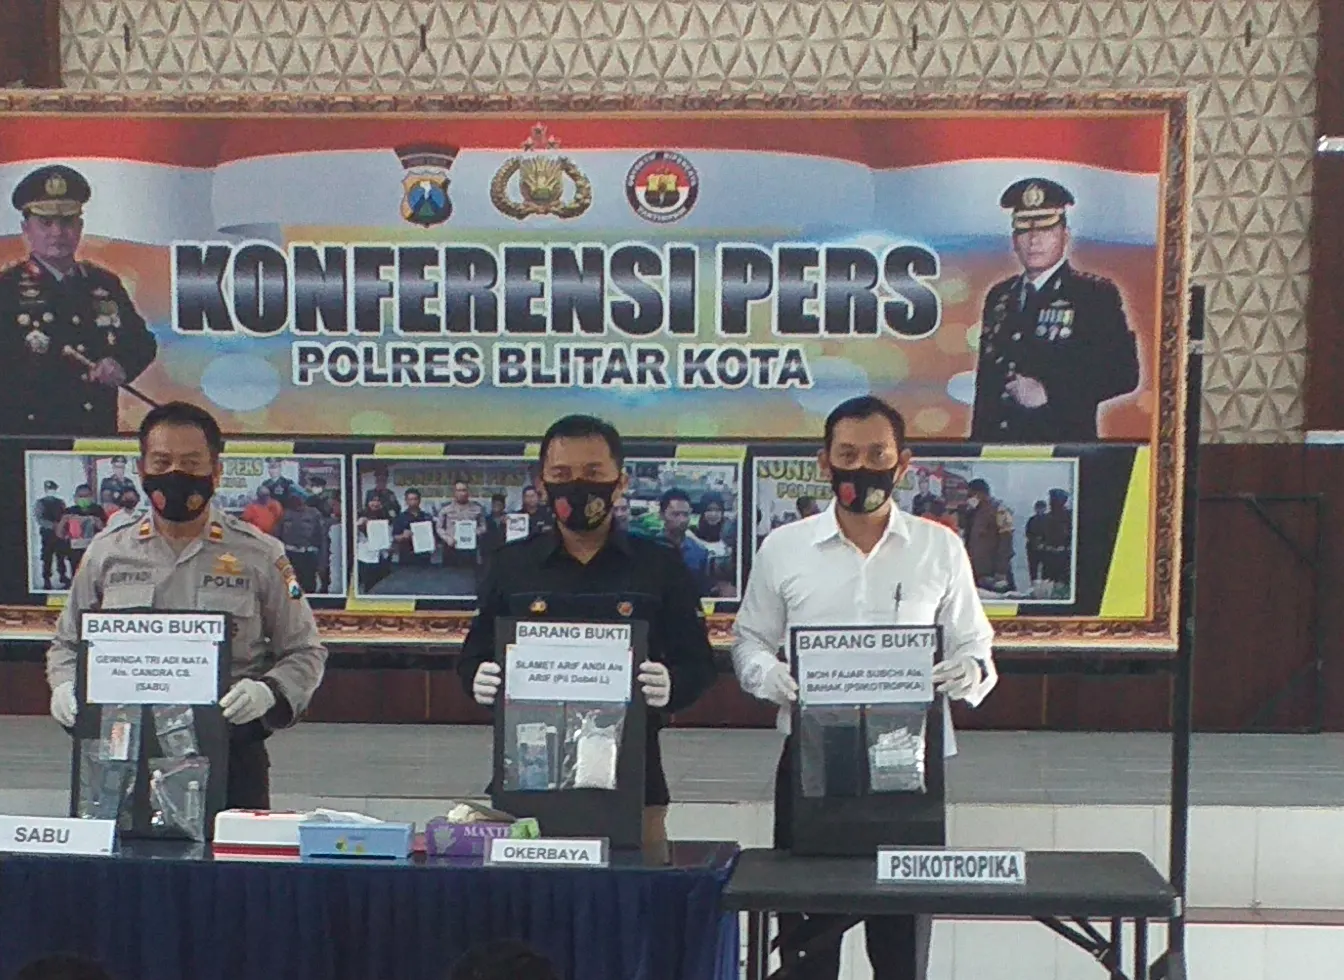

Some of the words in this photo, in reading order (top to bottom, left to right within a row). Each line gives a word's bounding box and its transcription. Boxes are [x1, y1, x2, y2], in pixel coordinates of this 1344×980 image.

[172, 241, 699, 336] KONFERENSI
[715, 241, 941, 338] PERS
[292, 342, 483, 388] POLRES
[493, 342, 668, 389] BLITAR
[677, 343, 813, 390] KOTA
[203, 575, 250, 590] POLRI
[87, 619, 163, 634] BARANG
[168, 620, 222, 634] BUKTI
[519, 625, 581, 639] BARANG
[585, 627, 629, 640] BUKTI
[799, 634, 876, 650] BARANG
[882, 633, 936, 648] BUKTI
[14, 827, 70, 844] SABU
[503, 846, 590, 862] OKERBAYA
[890, 855, 1020, 878] PSIKOTROPIKA
